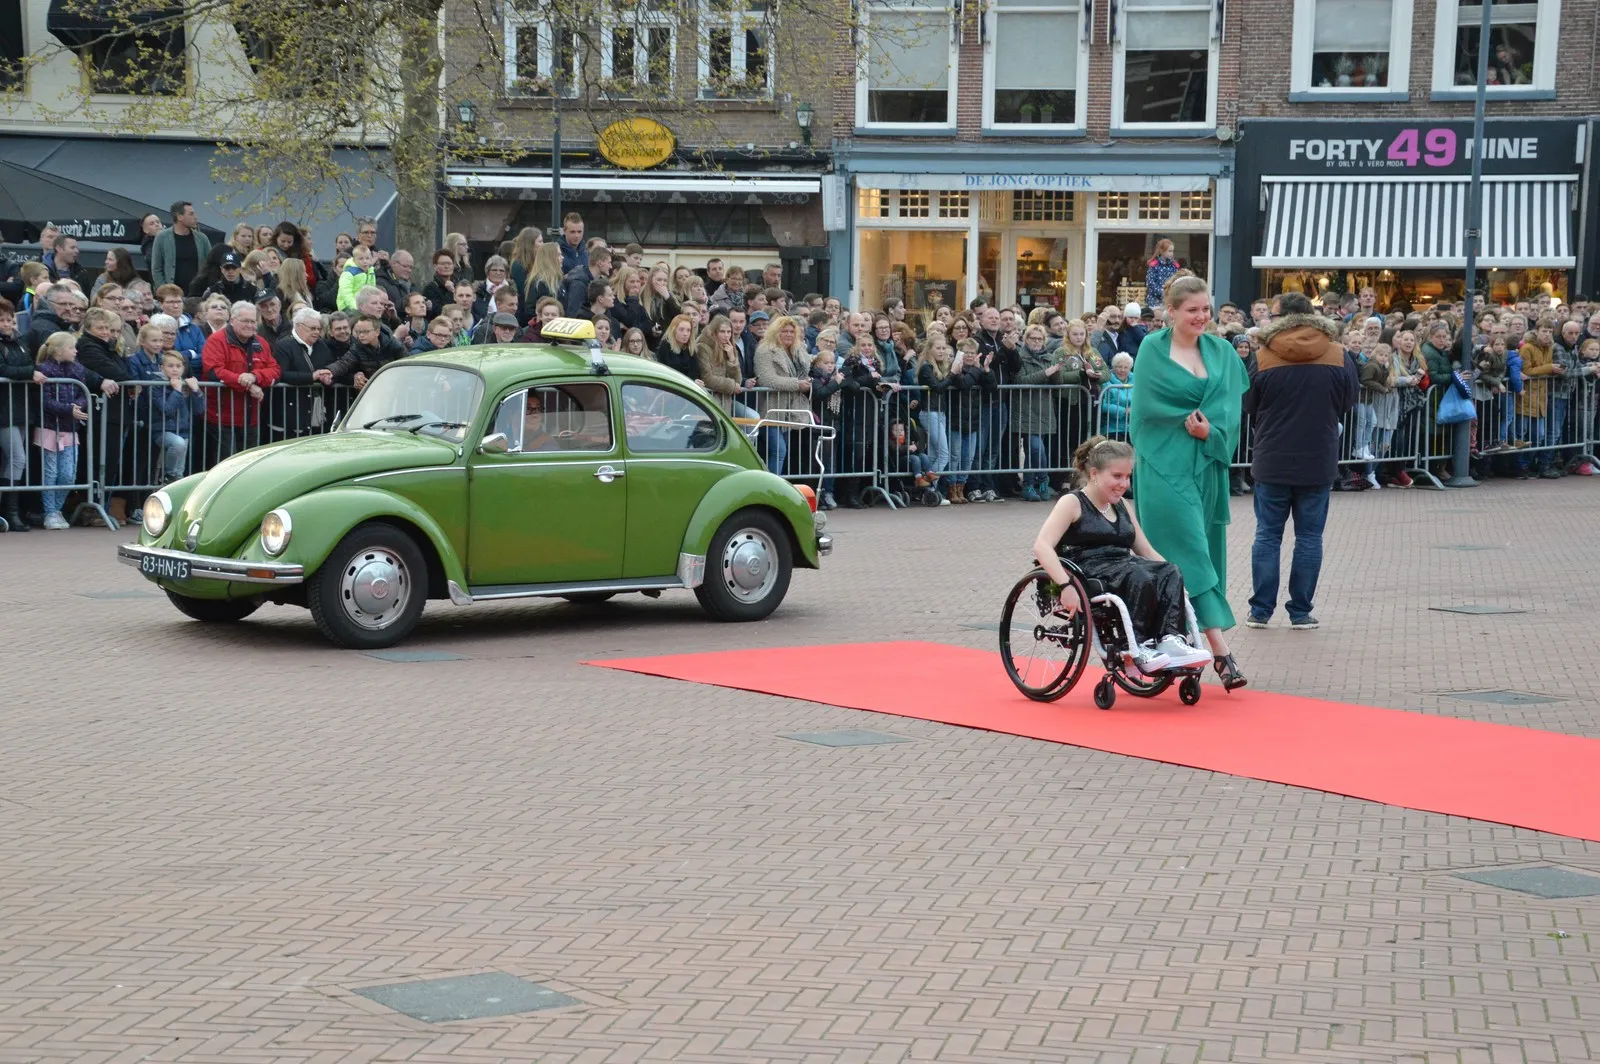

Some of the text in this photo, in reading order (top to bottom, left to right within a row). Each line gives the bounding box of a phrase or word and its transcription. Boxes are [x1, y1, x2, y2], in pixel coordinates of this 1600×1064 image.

[1289, 128, 1538, 167] FORTY 49 NINE
[965, 175, 1092, 187] DE JONG OPTIEK
[84, 219, 101, 237] Zus
[102, 223, 111, 236] en
[113, 219, 125, 236] Zo
[543, 319, 582, 335] TAXI
[142, 555, 188, 578] 83-HN-15
